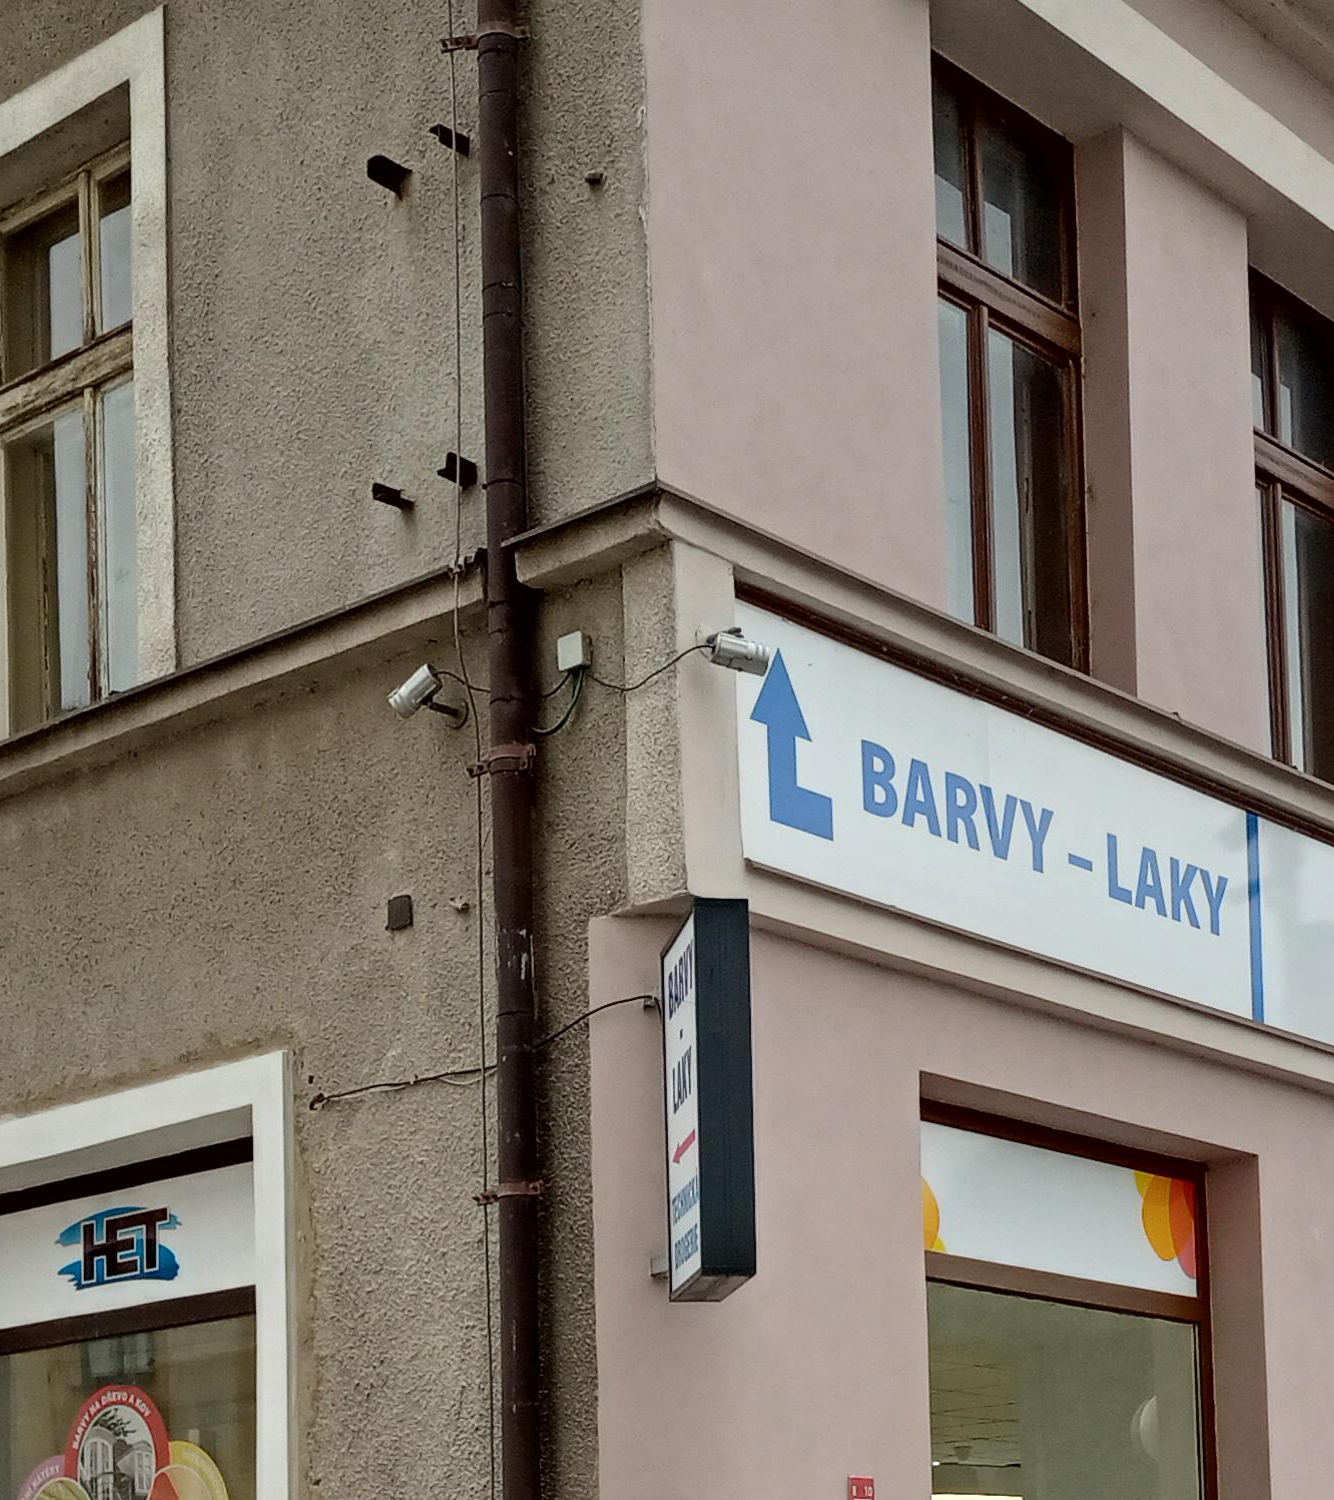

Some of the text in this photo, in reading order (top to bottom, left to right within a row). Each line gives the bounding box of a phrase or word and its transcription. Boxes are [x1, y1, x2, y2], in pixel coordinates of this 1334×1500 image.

[861, 739, 1054, 873] BARVY
[1107, 832, 1228, 936] LAKY
[669, 939, 694, 1020] BARVY
[672, 1045, 692, 1115] LAKY
[81, 1206, 170, 1285] HET
